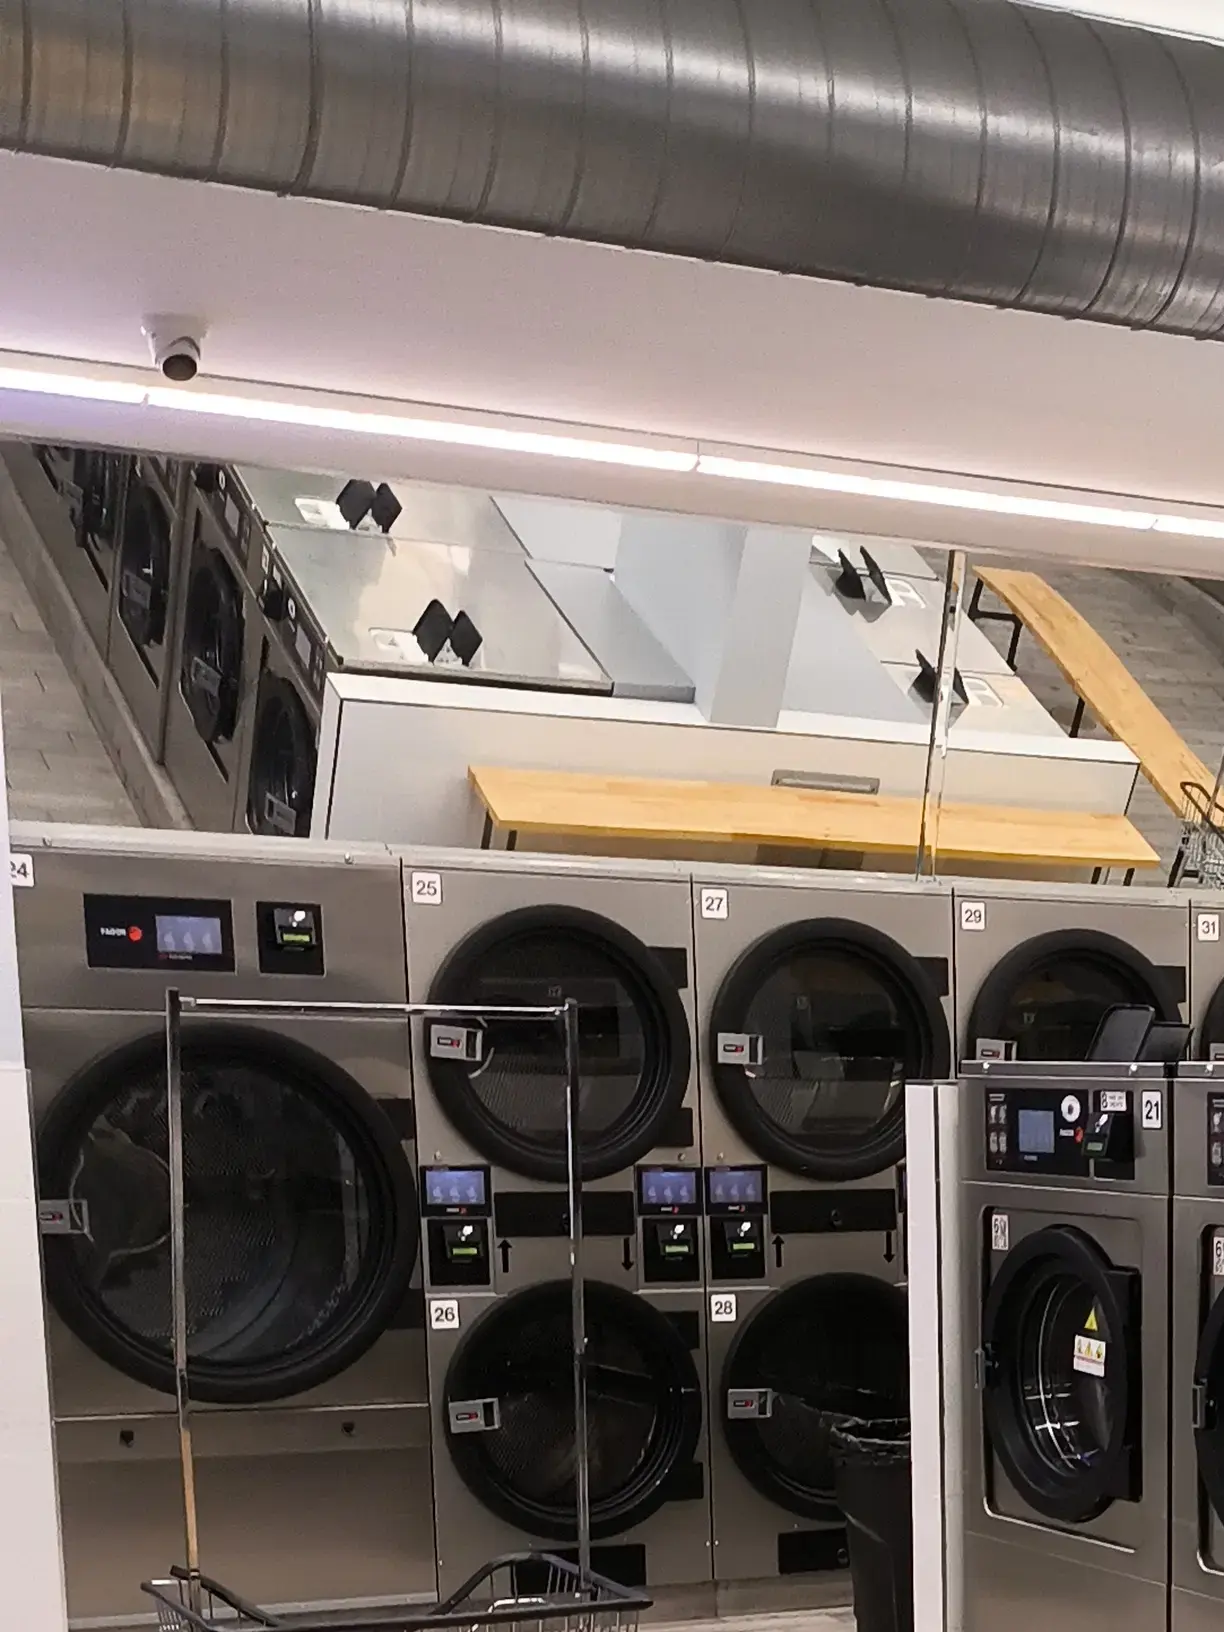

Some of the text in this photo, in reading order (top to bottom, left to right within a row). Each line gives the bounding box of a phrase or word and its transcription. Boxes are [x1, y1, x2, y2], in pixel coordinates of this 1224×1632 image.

[416, 879, 437, 897] 25
[705, 895, 724, 912] 27
[964, 909, 982, 924] 29
[1201, 920, 1216, 935] 31
[1145, 1099, 1159, 1121] 21
[1216, 1240, 1222, 1258] 6
[434, 1306, 455, 1323] 26
[714, 1300, 733, 1316] 28
